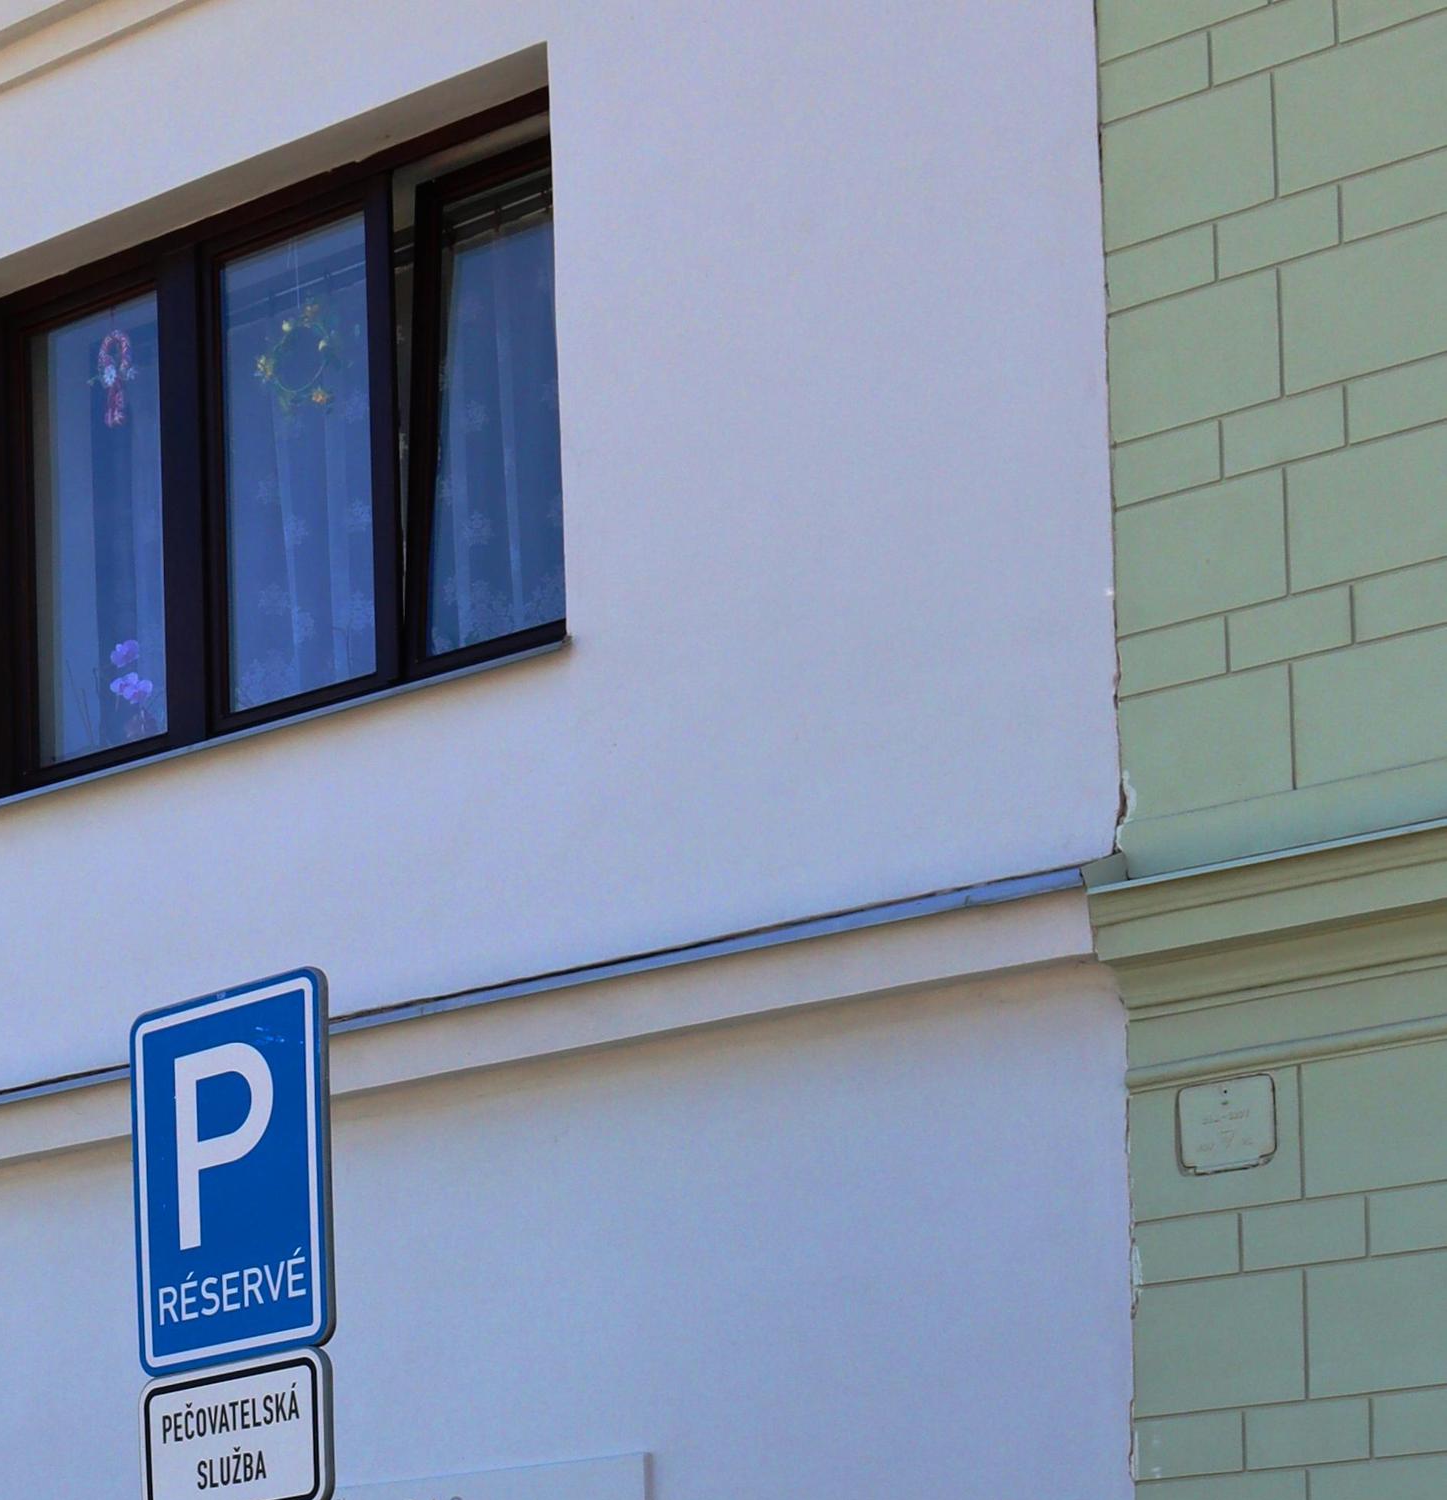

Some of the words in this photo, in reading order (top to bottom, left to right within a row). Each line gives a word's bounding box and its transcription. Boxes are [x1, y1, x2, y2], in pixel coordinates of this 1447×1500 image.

[174, 1042, 274, 1251] P
[157, 1246, 307, 1325] RÉSERVÉ
[161, 1382, 300, 1444] PEČOVATELSKÁ
[196, 1446, 267, 1491] SLUŽBA
